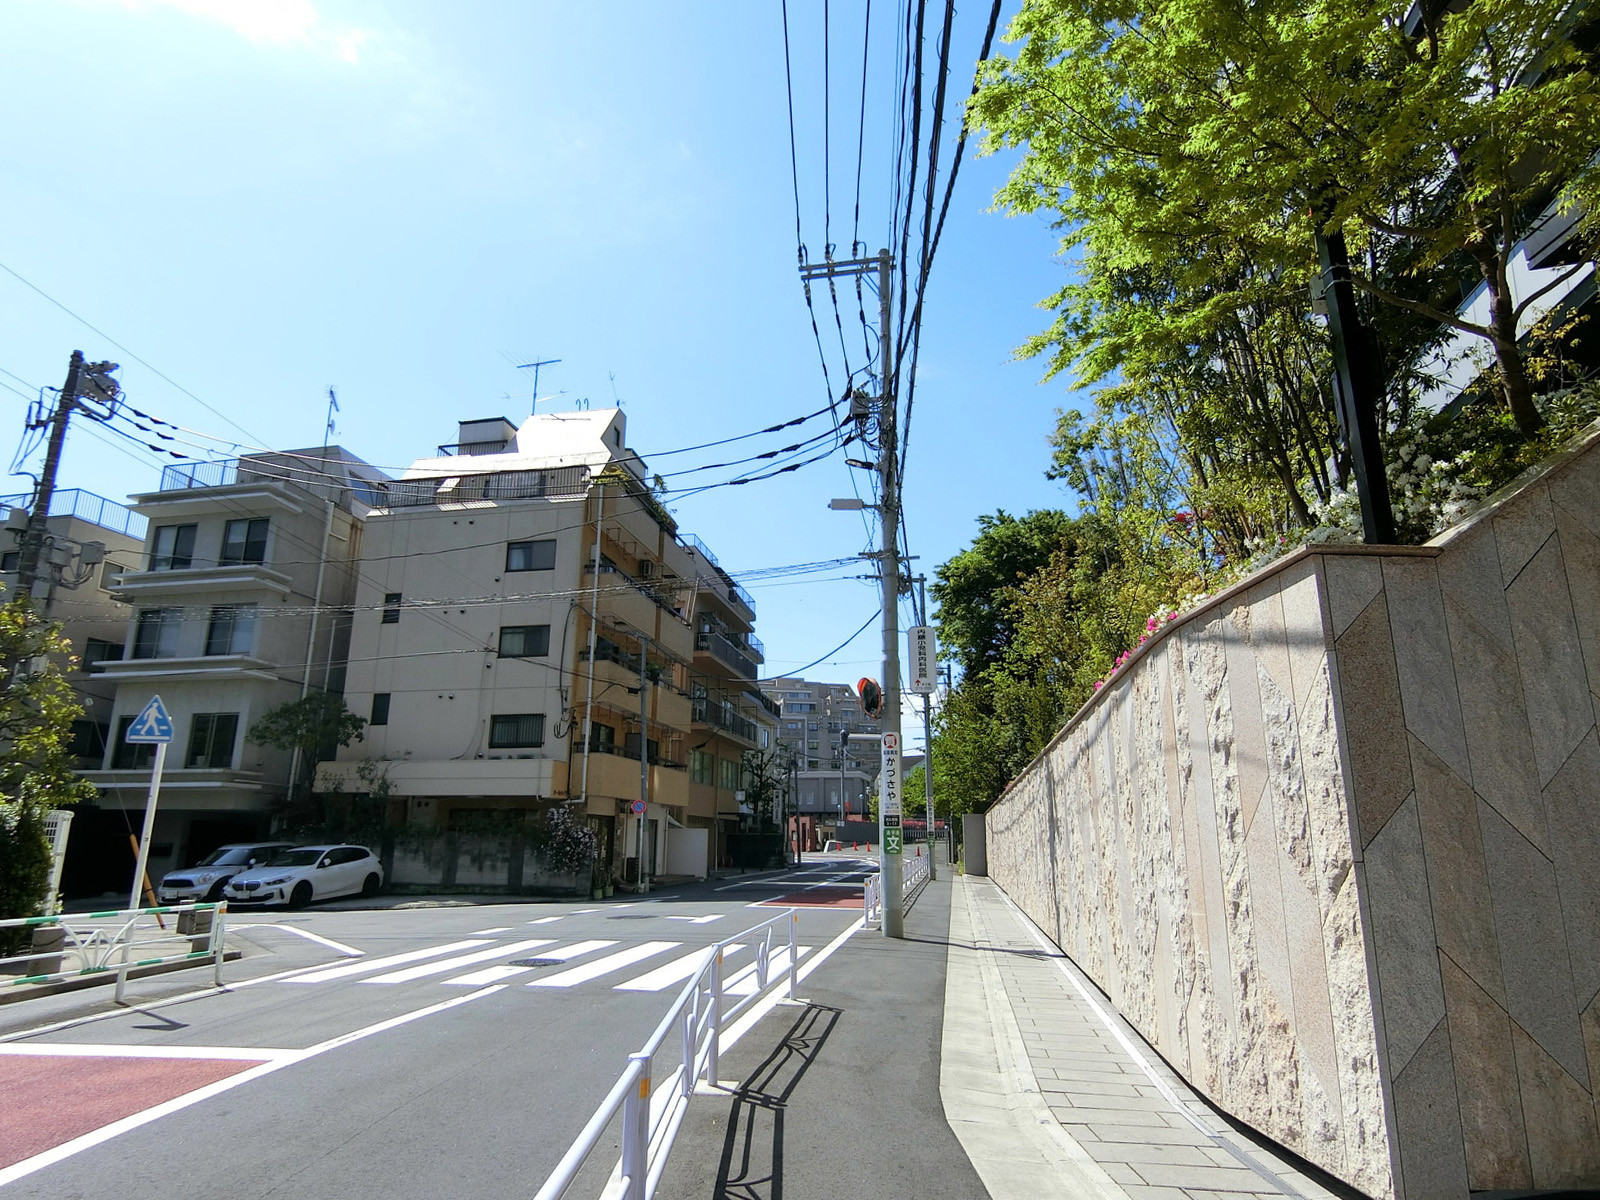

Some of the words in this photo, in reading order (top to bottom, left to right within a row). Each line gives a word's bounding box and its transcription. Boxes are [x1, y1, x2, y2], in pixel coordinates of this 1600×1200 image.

[886, 757, 897, 800] かづさや
[886, 835, 900, 850] 文
